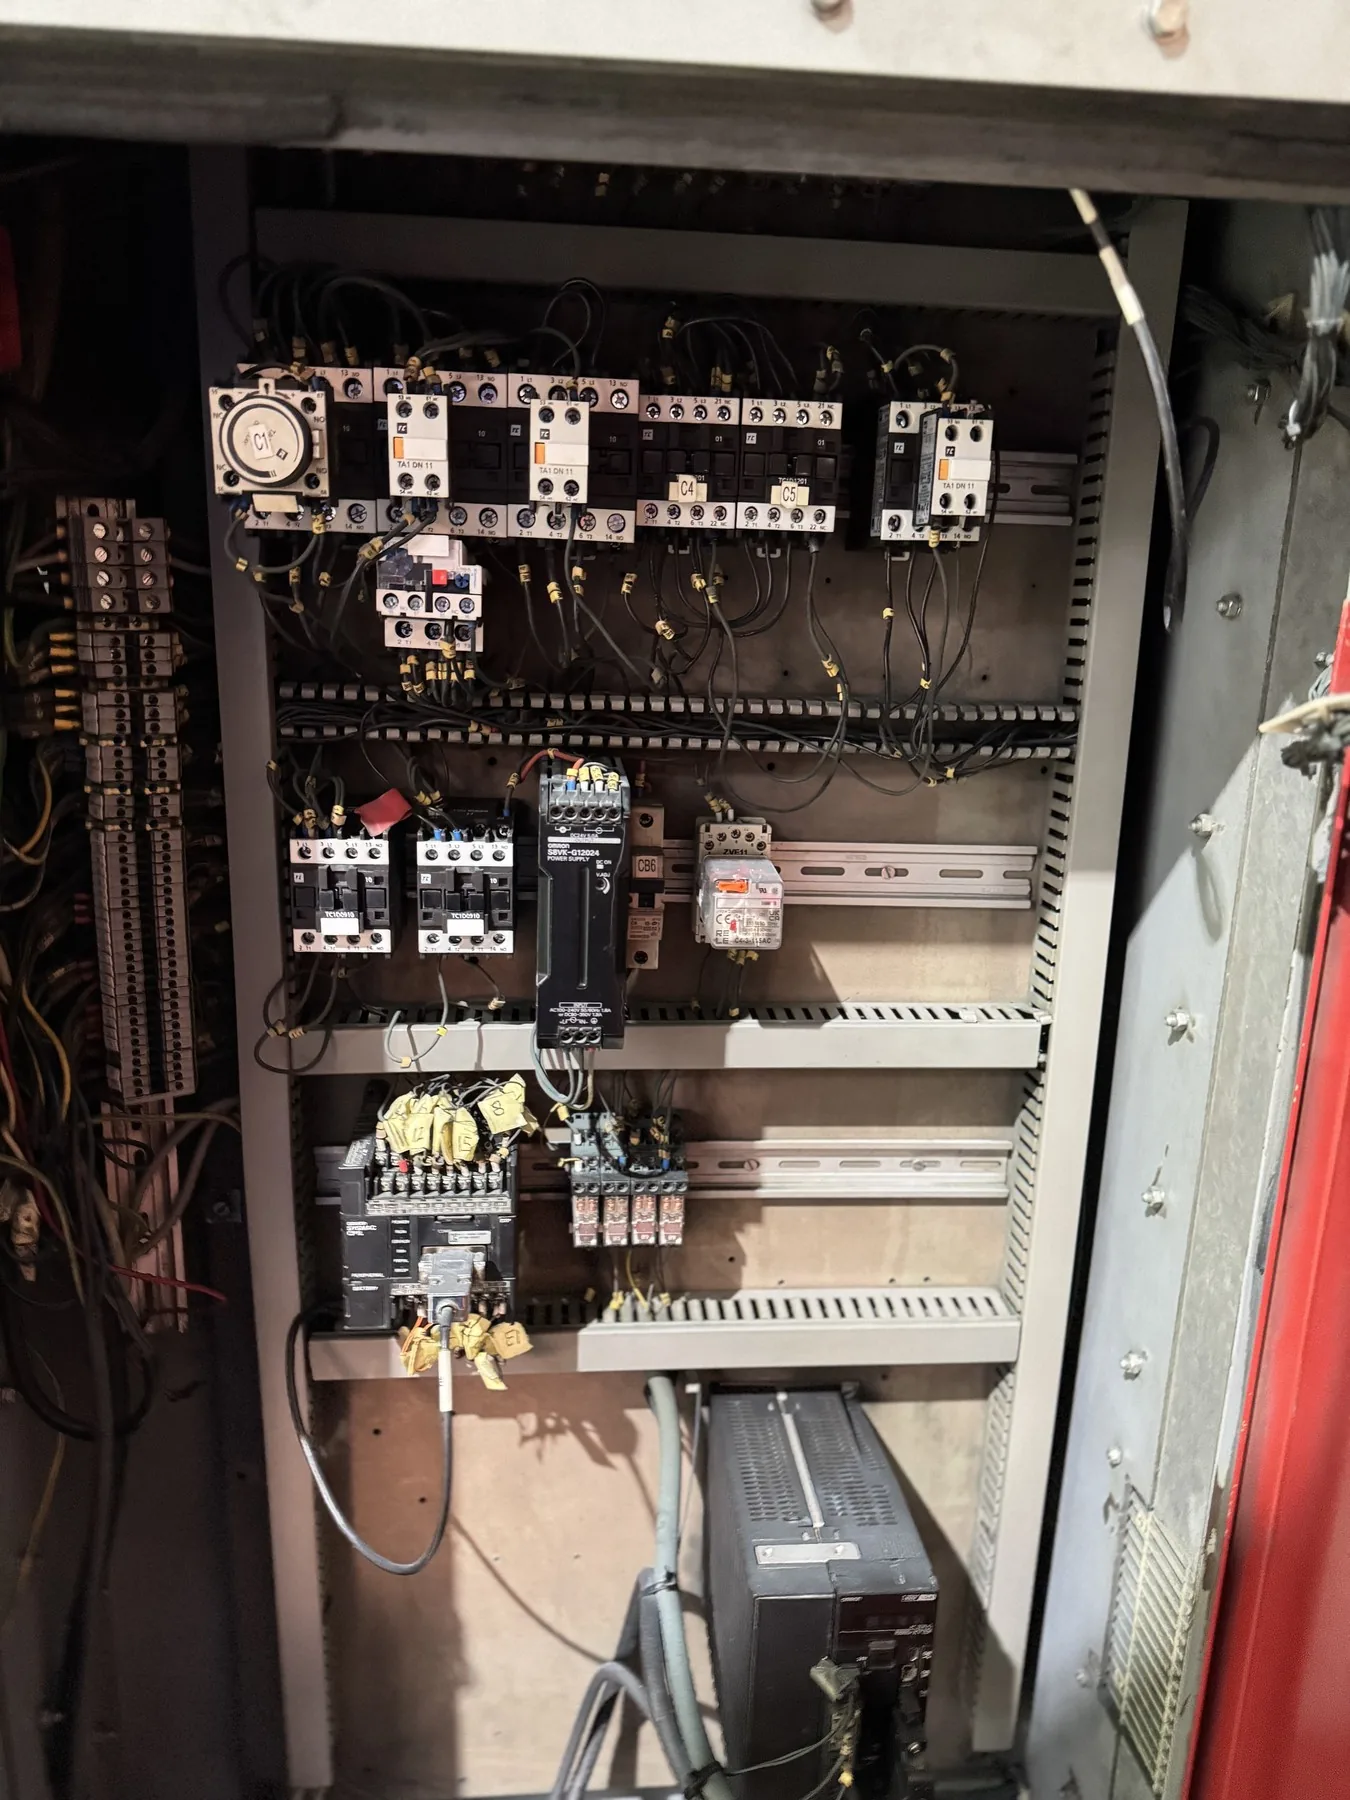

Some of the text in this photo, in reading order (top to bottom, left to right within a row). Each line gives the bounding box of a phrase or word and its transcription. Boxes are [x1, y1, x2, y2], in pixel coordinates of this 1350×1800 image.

[253, 432, 270, 451] C1
[680, 480, 694, 496] C4
[782, 486, 796, 502] C5
[637, 859, 656, 872] CB6
